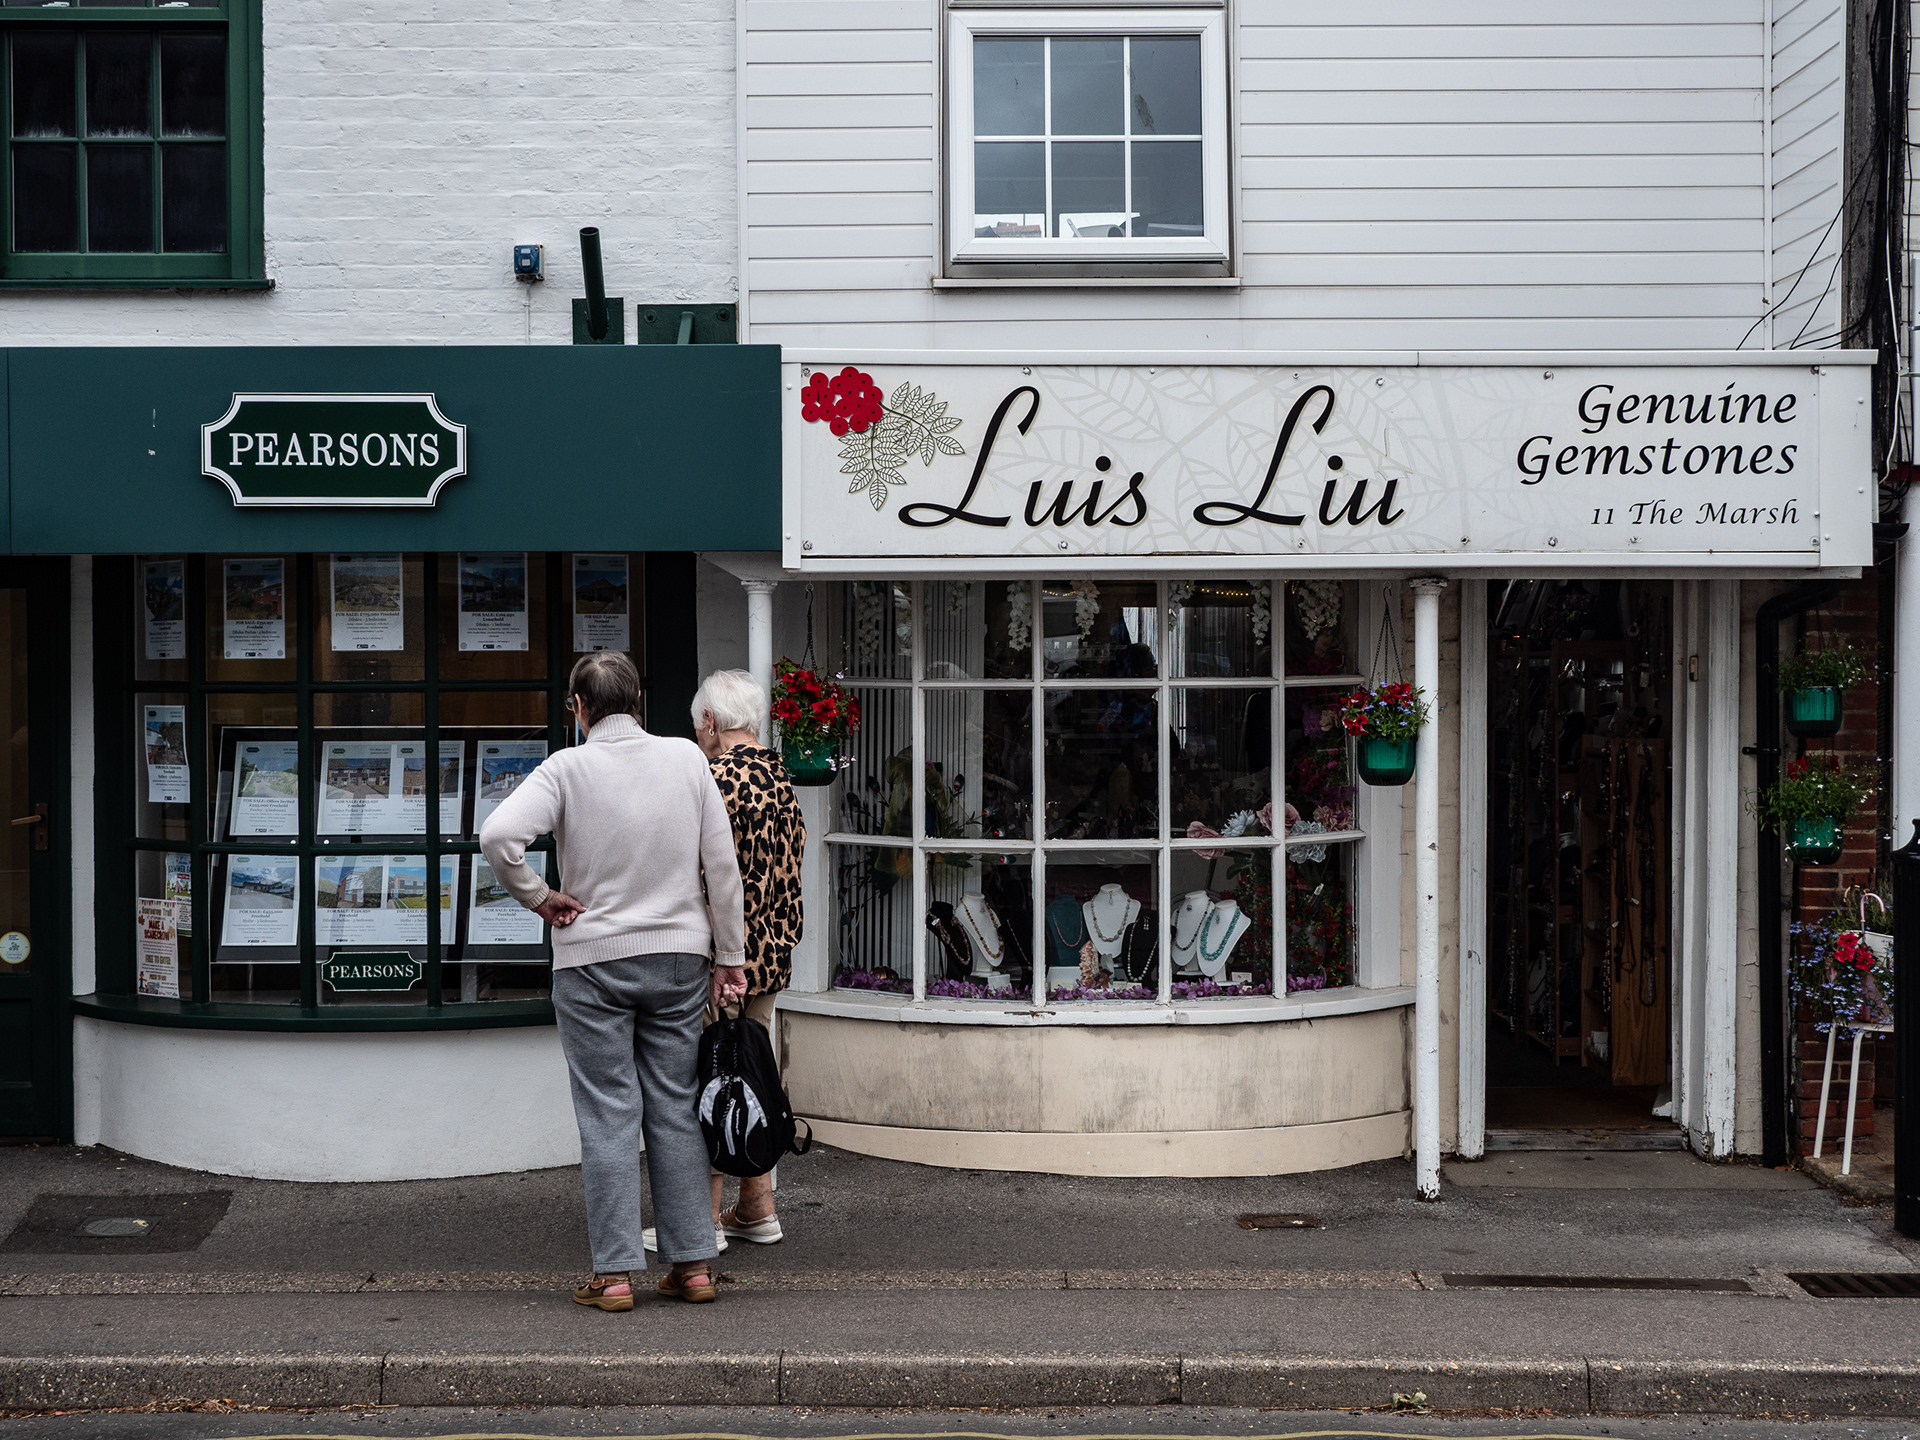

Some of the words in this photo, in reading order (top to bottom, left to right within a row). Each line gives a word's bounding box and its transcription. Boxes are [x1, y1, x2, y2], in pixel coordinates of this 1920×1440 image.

[1578, 382, 1797, 434] Genuine
[229, 432, 440, 467] PEARSONS
[898, 386, 1148, 527] Luis
[1193, 385, 1405, 527] Liu
[1516, 435, 1798, 485] Gemstones
[1591, 508, 1614, 525] 11
[1628, 499, 1683, 525] The
[1695, 499, 1800, 525] Marsh
[330, 964, 414, 978] PEARSONS
